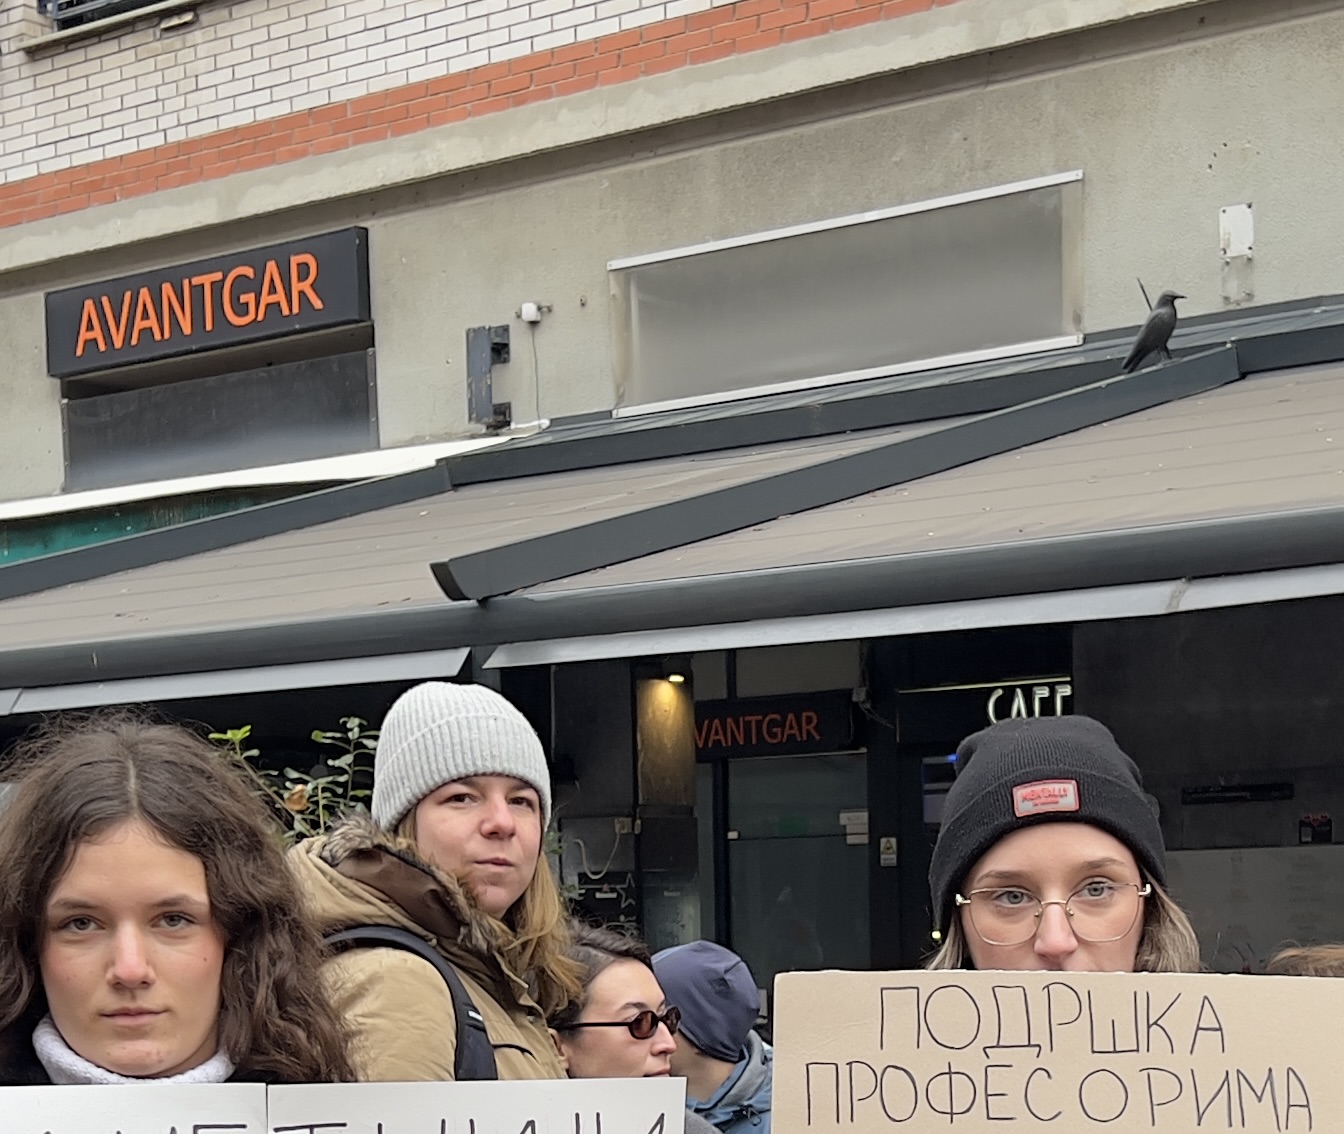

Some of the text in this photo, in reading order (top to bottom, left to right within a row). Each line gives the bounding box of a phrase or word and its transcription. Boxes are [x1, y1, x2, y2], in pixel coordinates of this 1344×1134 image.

[75, 252, 325, 357] AVANTGAR
[695, 711, 821, 748] VANTGAR
[879, 981, 1226, 1060] ПОДРШКА
[805, 1060, 1313, 1132] ПРОФЕСОРИМА
